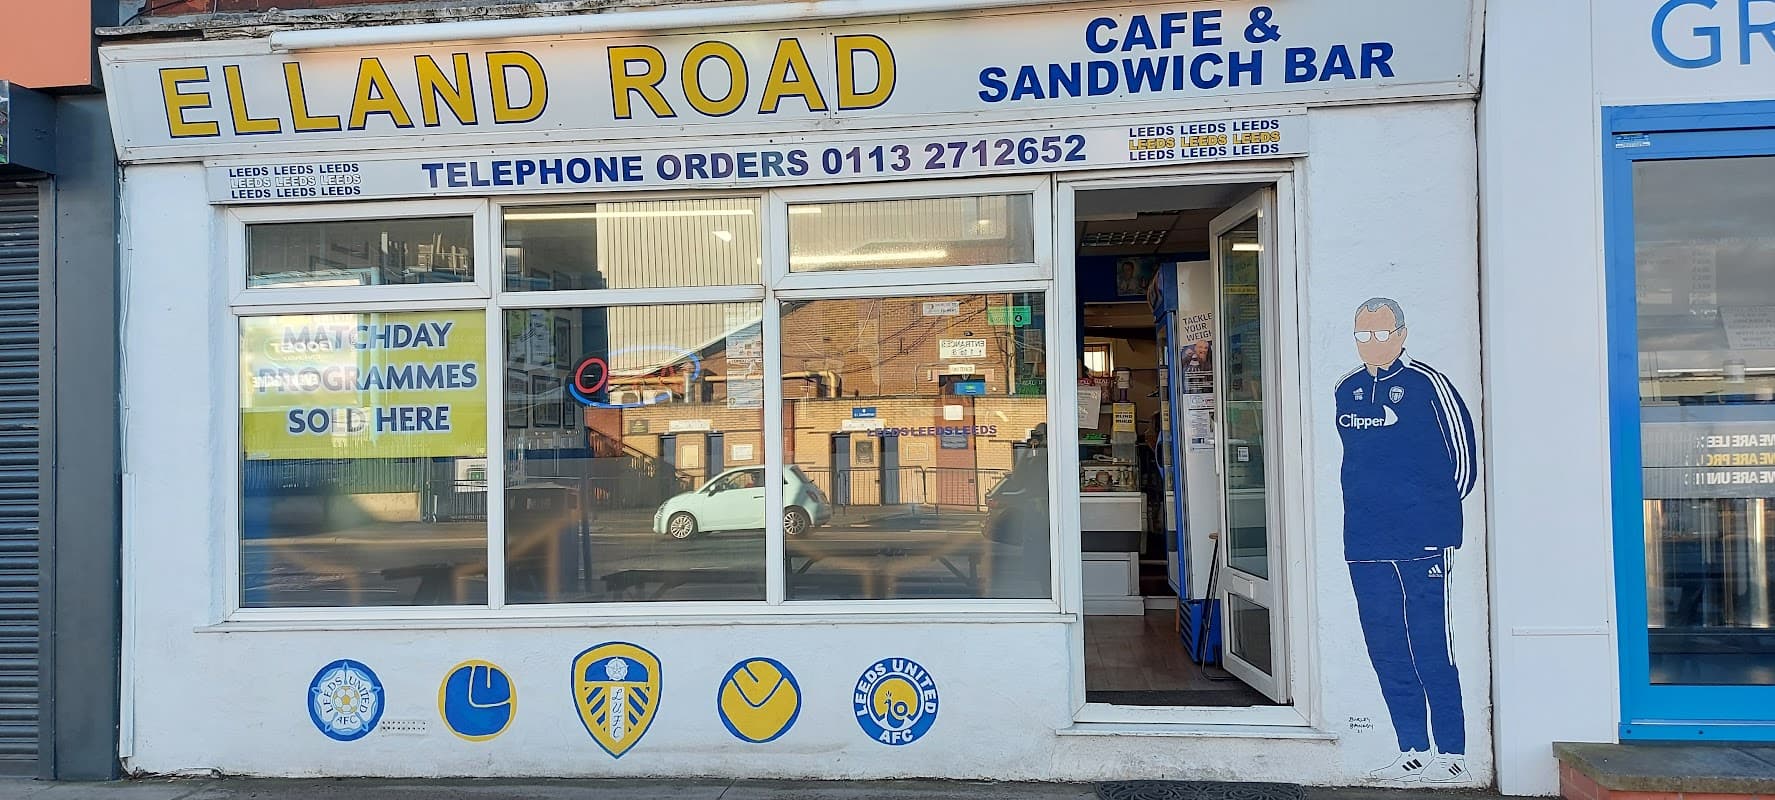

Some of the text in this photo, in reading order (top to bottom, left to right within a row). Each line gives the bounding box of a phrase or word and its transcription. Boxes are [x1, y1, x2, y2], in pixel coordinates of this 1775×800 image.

[1085, 6, 1281, 53] CAFE &
[978, 42, 1395, 103] SANDWICH BAR
[159, 34, 896, 138] ELLAND ROAD
[1129, 119, 1279, 138] LEEDS LEEDS LEEDS
[1129, 131, 1280, 150] LEEDS LEEDS LEEDS
[422, 134, 1086, 189] TELEPHONE ORDERS 0113 2712652
[1129, 143, 1279, 161] LEEDS LEEDS LEEDS
[229, 163, 359, 178] LEEDS LEEDS LEEDS
[231, 174, 361, 188] LEEDS LEEDS LEEDS
[231, 186, 361, 199] LEEDS LEEDS LEEDS
[1182, 312, 1213, 325] TACKLE
[1184, 322, 1208, 333] YOUR
[283, 322, 452, 350] MATCHDAY
[258, 363, 477, 393] PROGRAMMES
[289, 406, 450, 433] SOLD HERE
[1339, 413, 1385, 430] Clipper
[323, 676, 370, 713] LEEDS UNITED
[855, 659, 937, 716] LEEDS UNITED
[336, 715, 358, 725] AFC
[879, 729, 913, 744] AFC
